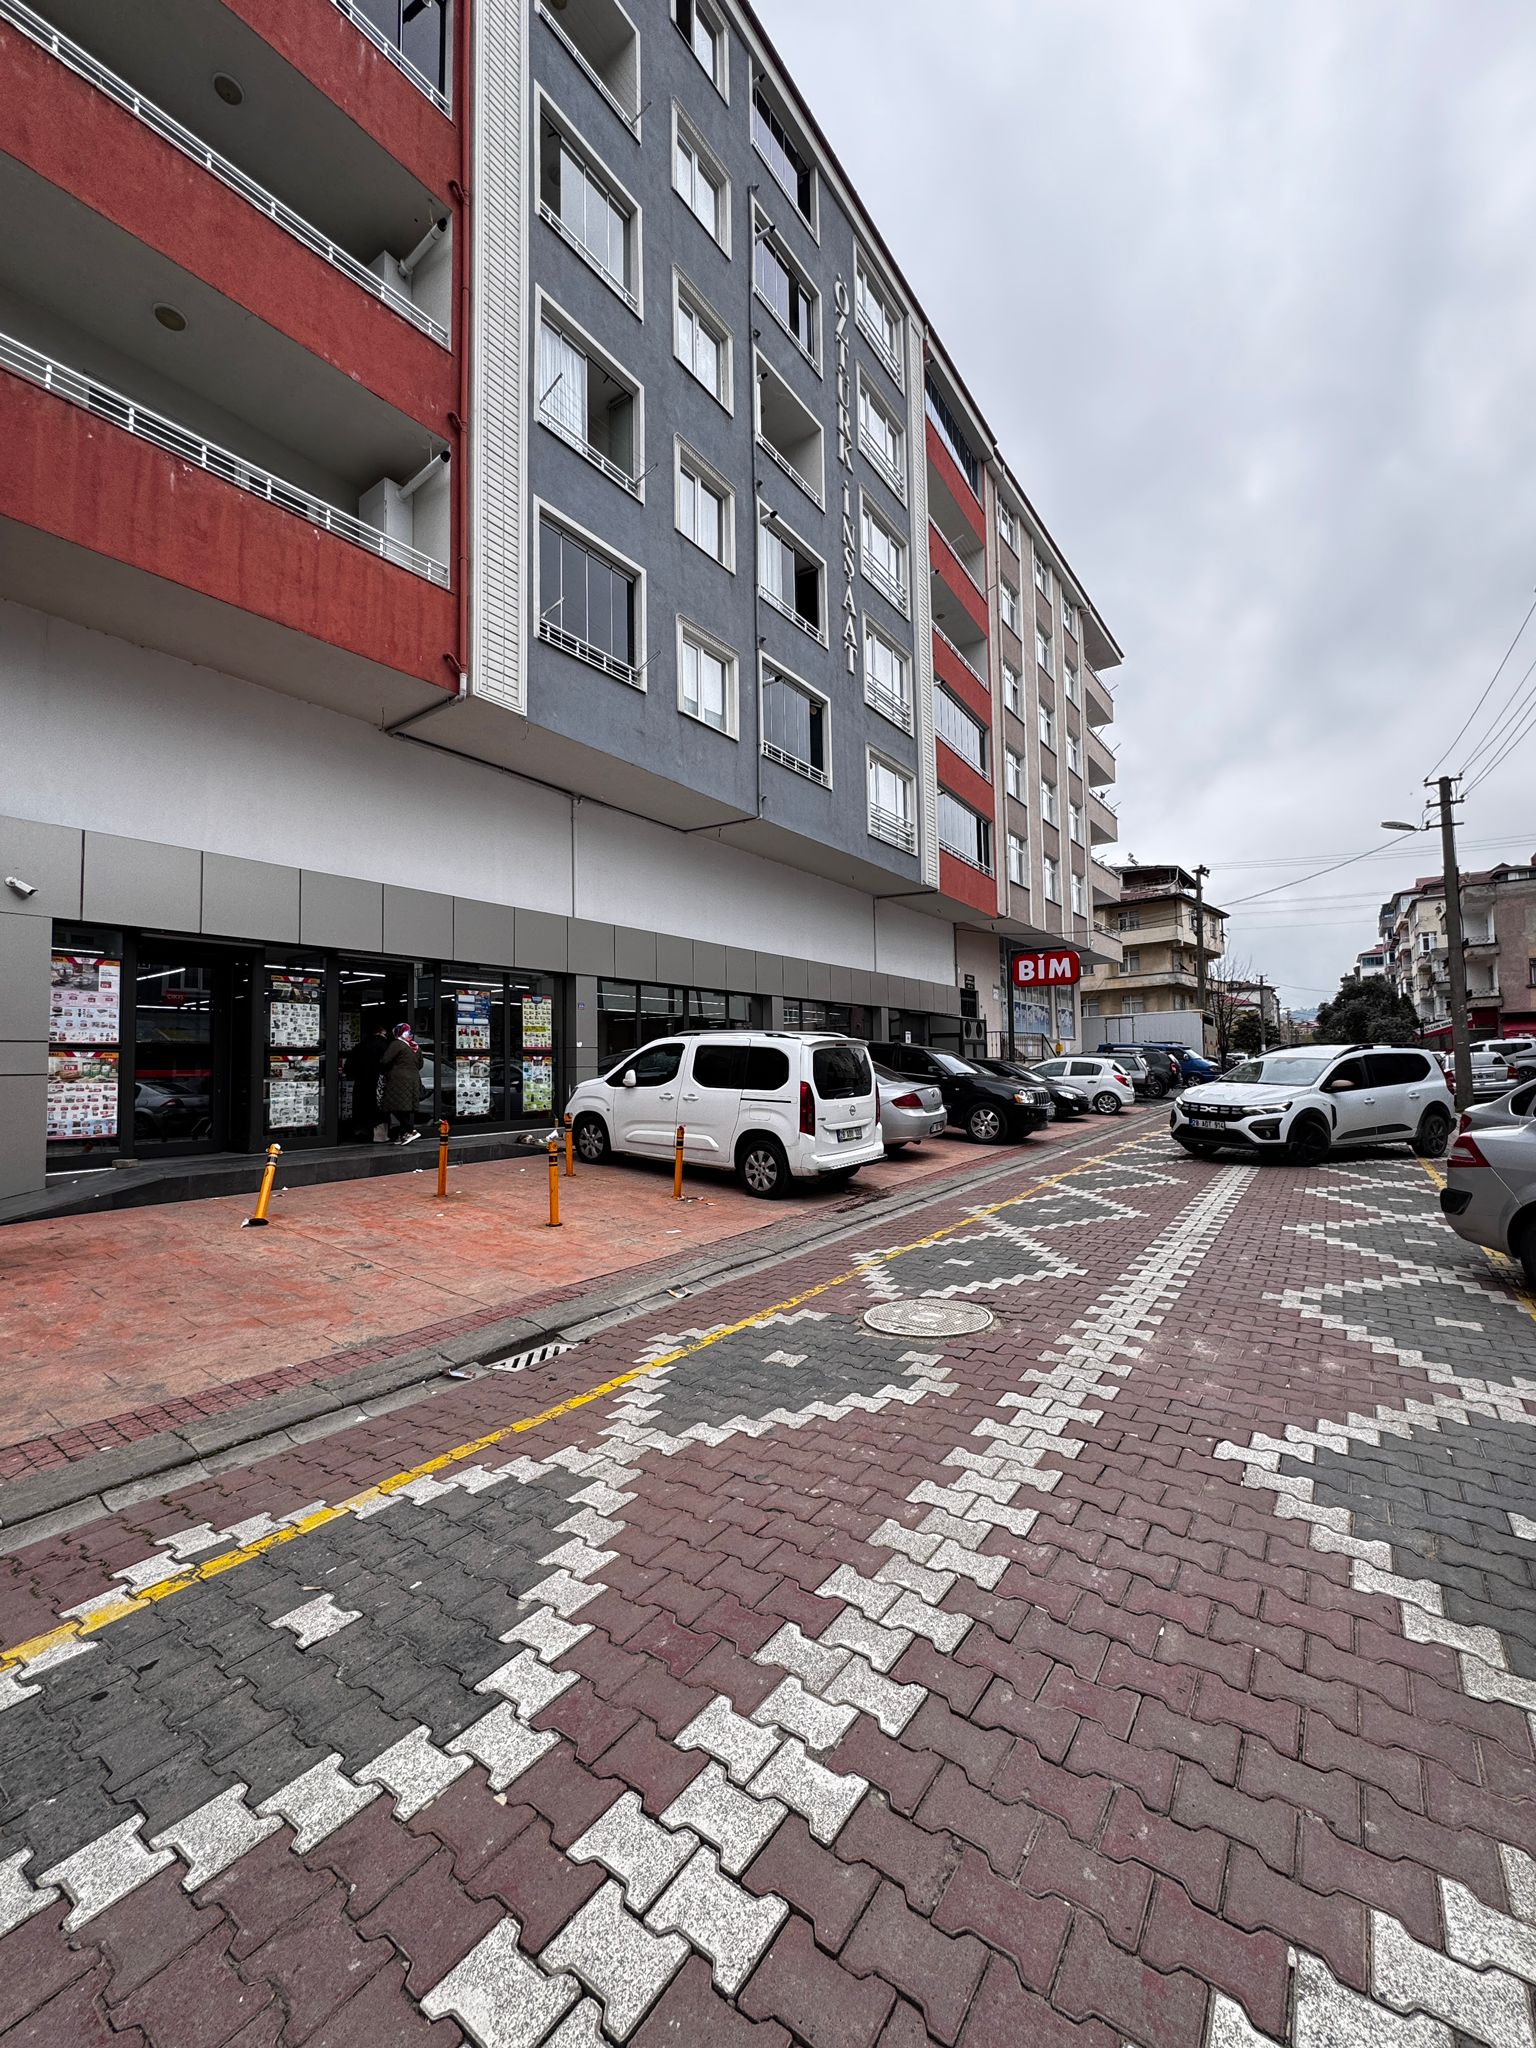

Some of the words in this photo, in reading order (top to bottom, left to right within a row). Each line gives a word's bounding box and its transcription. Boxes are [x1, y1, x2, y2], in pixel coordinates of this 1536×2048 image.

[833, 273, 854, 474] ÖZTÜRK
[840, 480, 858, 676] İNŞAAT
[1019, 954, 1071, 981] BİM
